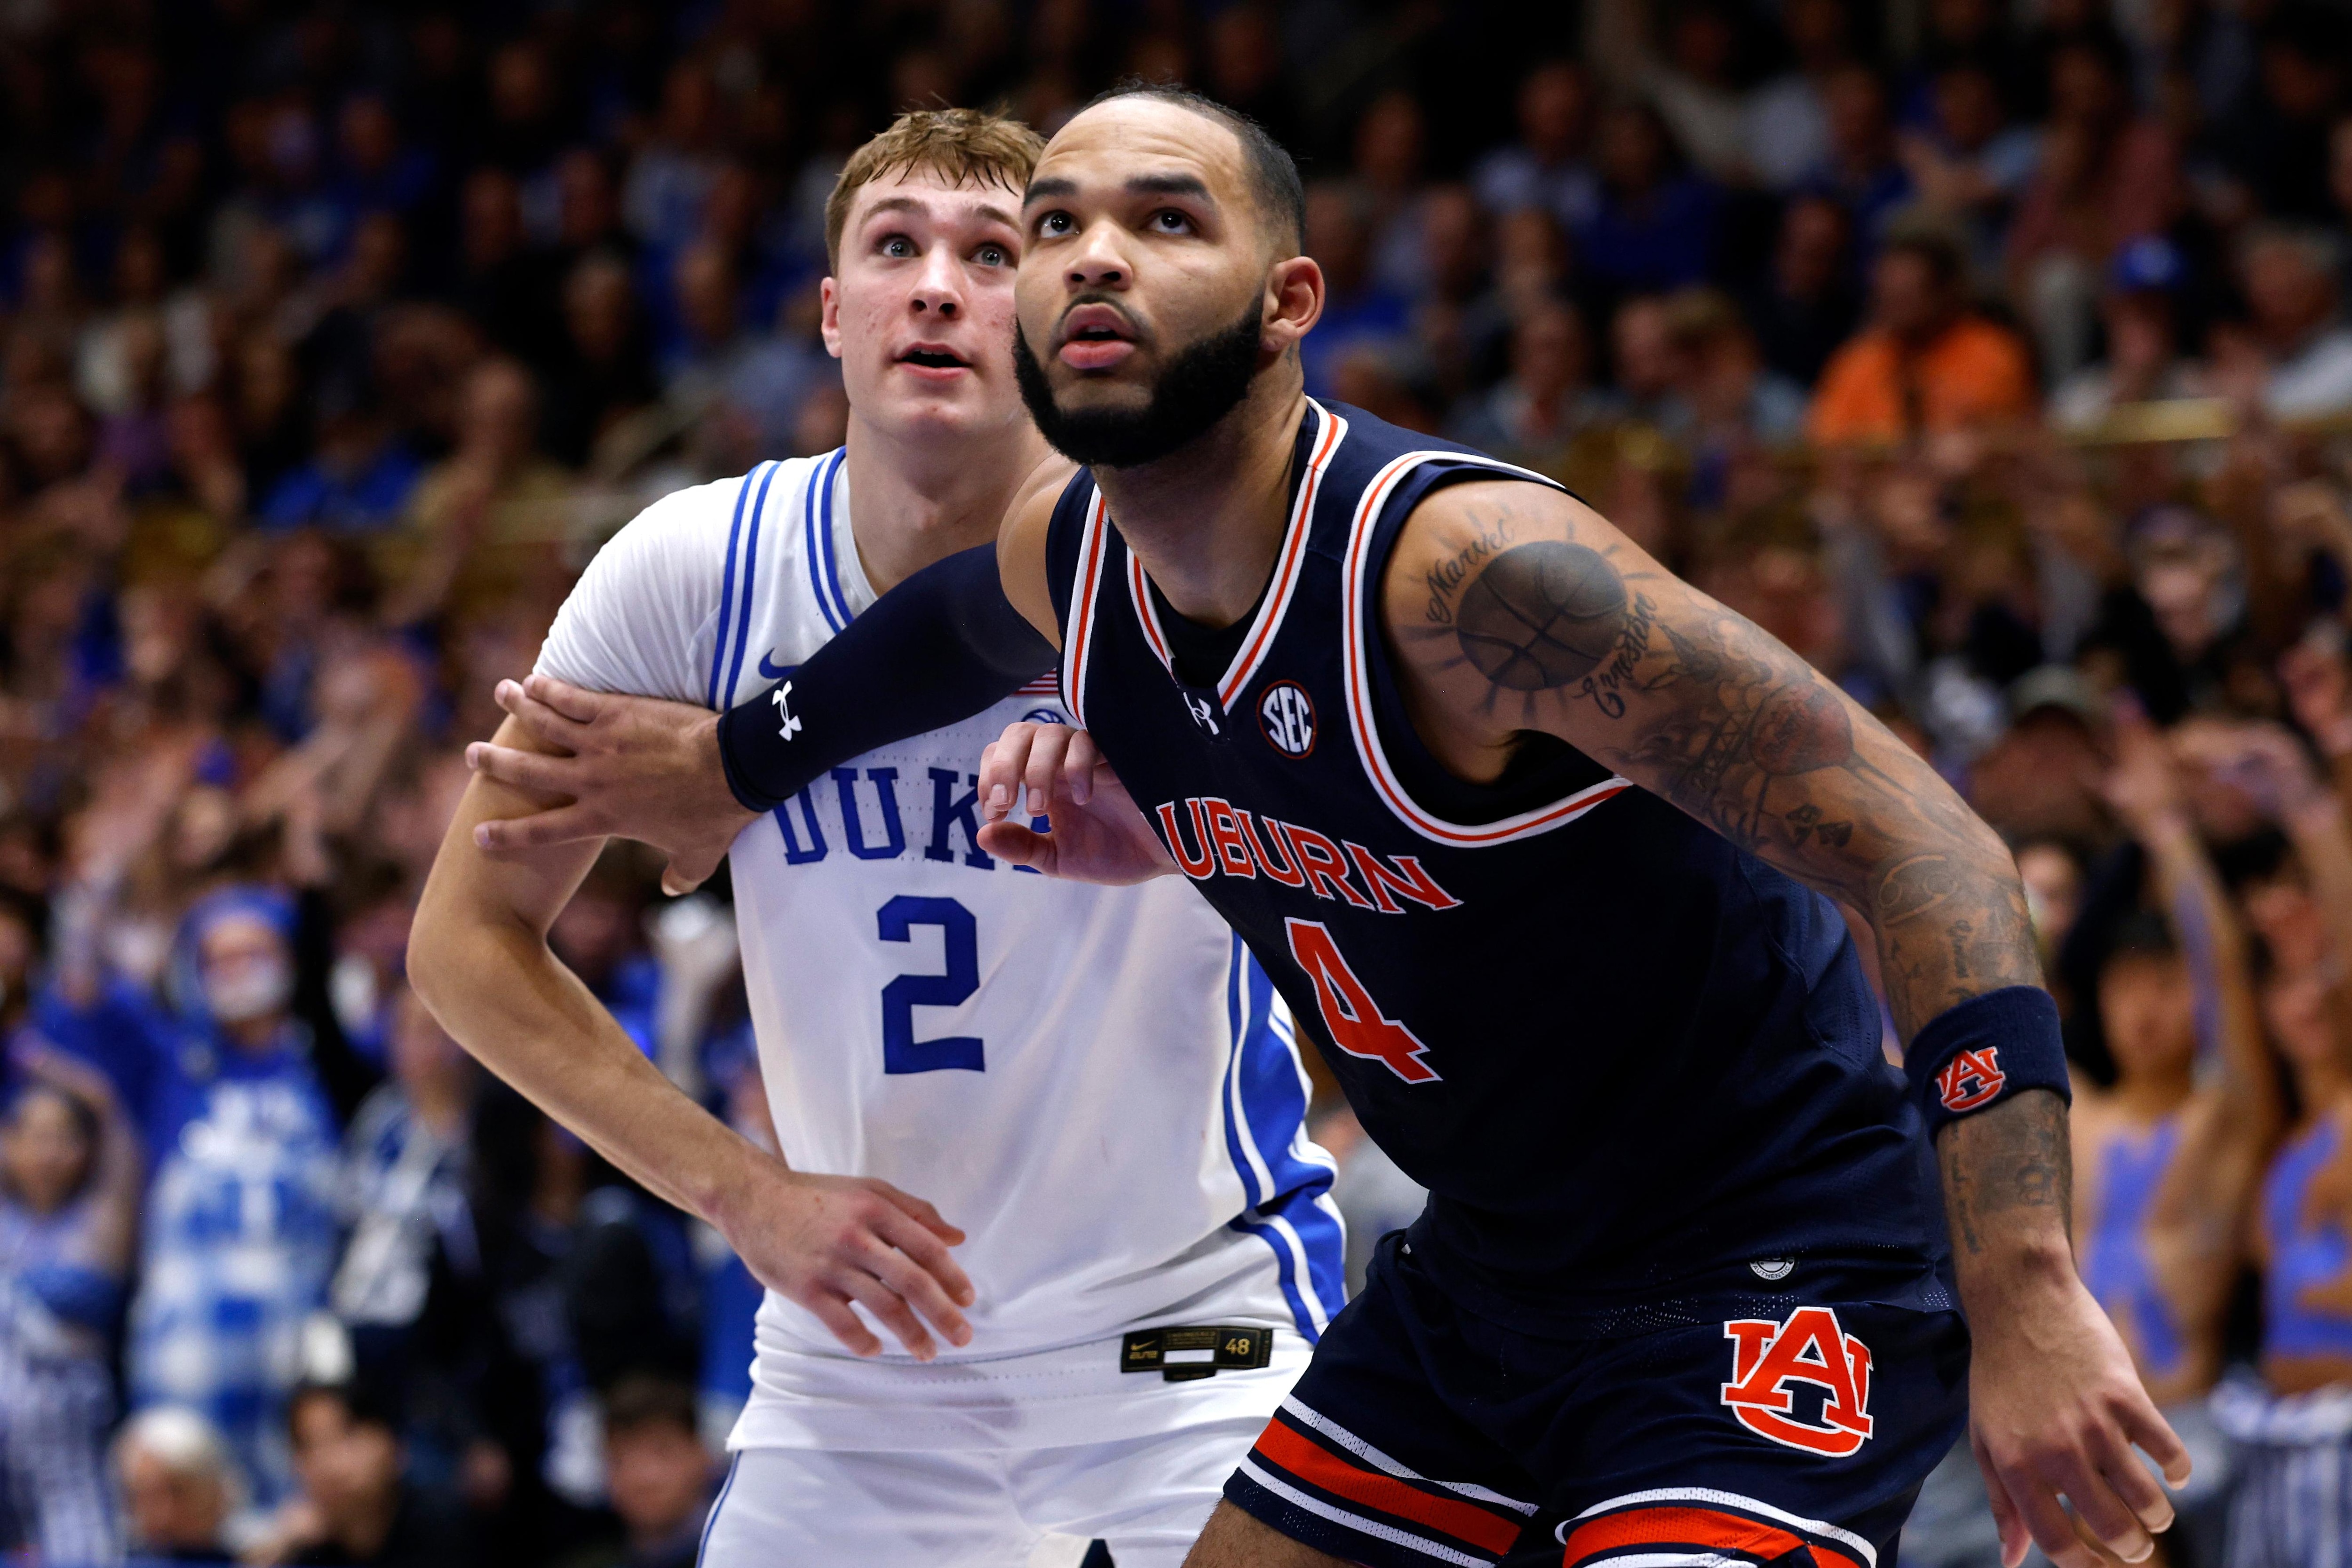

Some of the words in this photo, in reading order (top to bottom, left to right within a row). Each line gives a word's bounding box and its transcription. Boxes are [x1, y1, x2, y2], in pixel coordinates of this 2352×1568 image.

[1263, 686, 1312, 752] SEC
[773, 766, 1051, 874] DUK
[1155, 797, 1464, 913] UBURN
[876, 895, 985, 1074] 2
[1284, 916, 1443, 1085] 4
[1752, 1264, 1791, 1279] AUTHENTIC
[1225, 1337, 1251, 1356] 48
